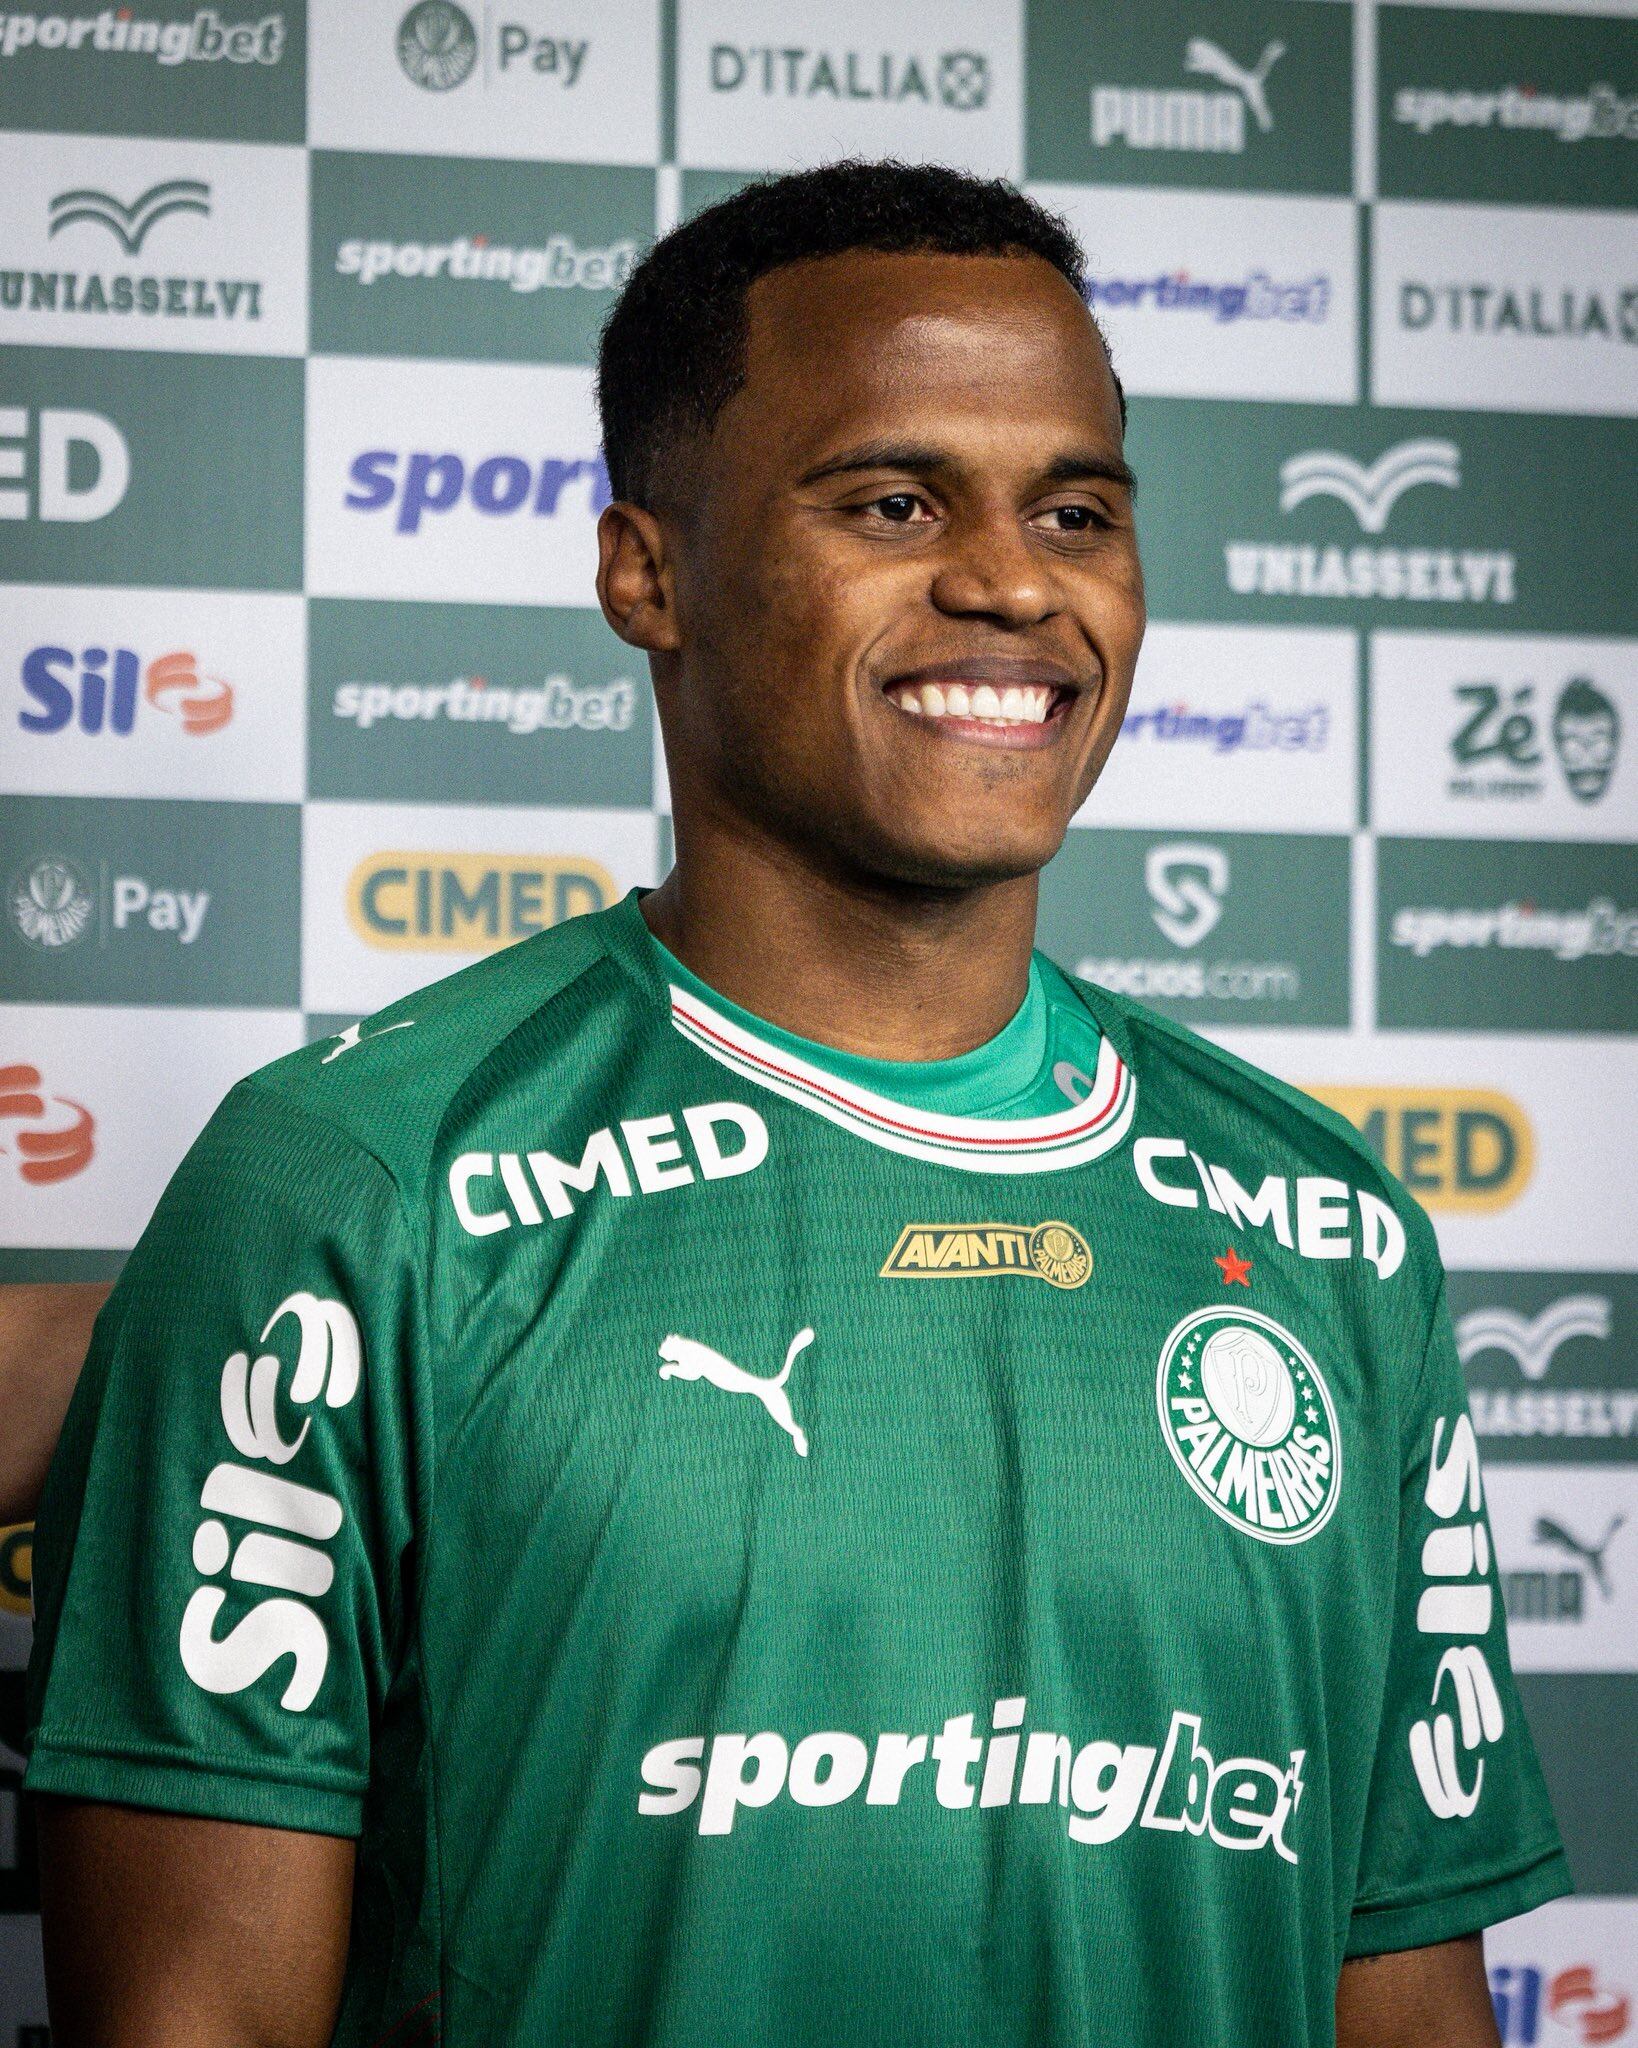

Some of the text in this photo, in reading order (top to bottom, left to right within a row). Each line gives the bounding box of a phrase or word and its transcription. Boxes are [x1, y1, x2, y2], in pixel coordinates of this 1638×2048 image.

[0, 9, 285, 65] portingbet
[500, 25, 589, 88] Pay
[711, 44, 931, 102] D'ITALIA
[0, 271, 263, 321] UNIASSELVI
[335, 235, 637, 292] sportingbet
[1226, 543, 1515, 603] UNIASSELVI
[18, 646, 140, 736] Sil
[333, 675, 633, 734] sportingbet
[1451, 681, 1543, 768] Zé
[112, 877, 210, 944] Pay
[360, 868, 605, 938] CIMED
[448, 1101, 769, 1237] CIMED
[1132, 1137, 1406, 1279] CIMED
[896, 1231, 1030, 1269] AVANTI
[1033, 1248, 1089, 1285] PALMEIRAS
[1170, 1396, 1332, 1530] PALMEIRAS
[1416, 1412, 1491, 1635] Sil
[179, 1461, 344, 1713] Sil
[637, 1697, 1308, 1866] sportingbet
